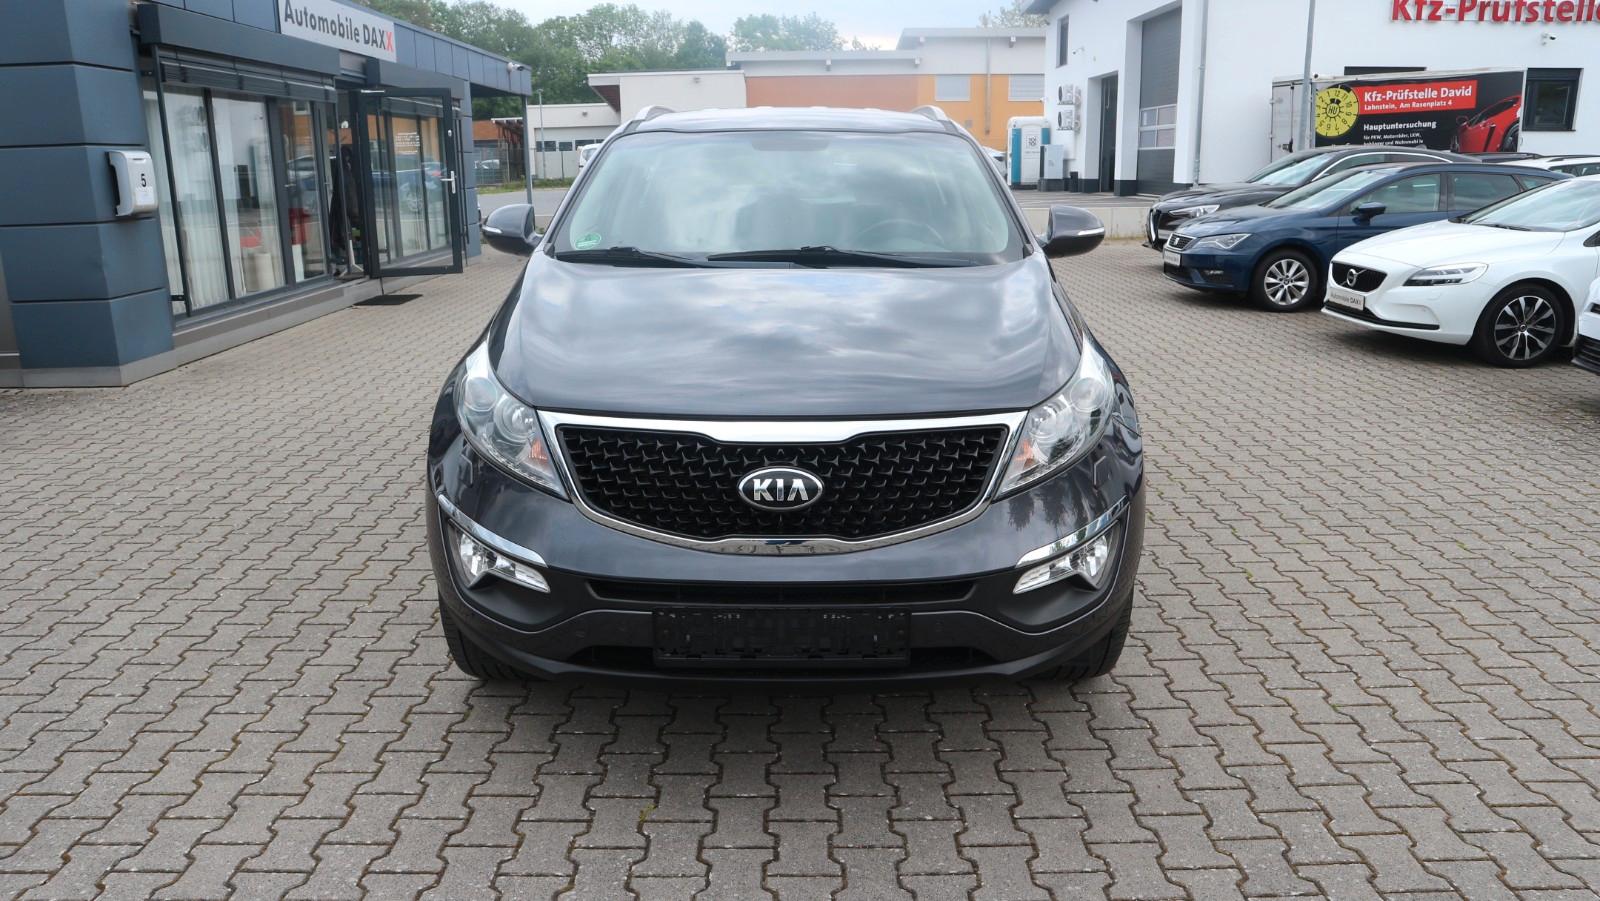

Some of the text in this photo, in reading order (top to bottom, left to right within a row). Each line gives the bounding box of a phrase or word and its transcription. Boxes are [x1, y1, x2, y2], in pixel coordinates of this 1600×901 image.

[284, 0, 394, 52] Automobile DAXX
[1364, 85, 1472, 102] Kfz-Prüfstelle David
[1328, 105, 1338, 115] HU
[1364, 103, 1398, 111] Lahnstein,
[1363, 120, 1437, 132] Hauptuntersuchung
[140, 173, 147, 188] 5
[753, 478, 809, 501] KIA
